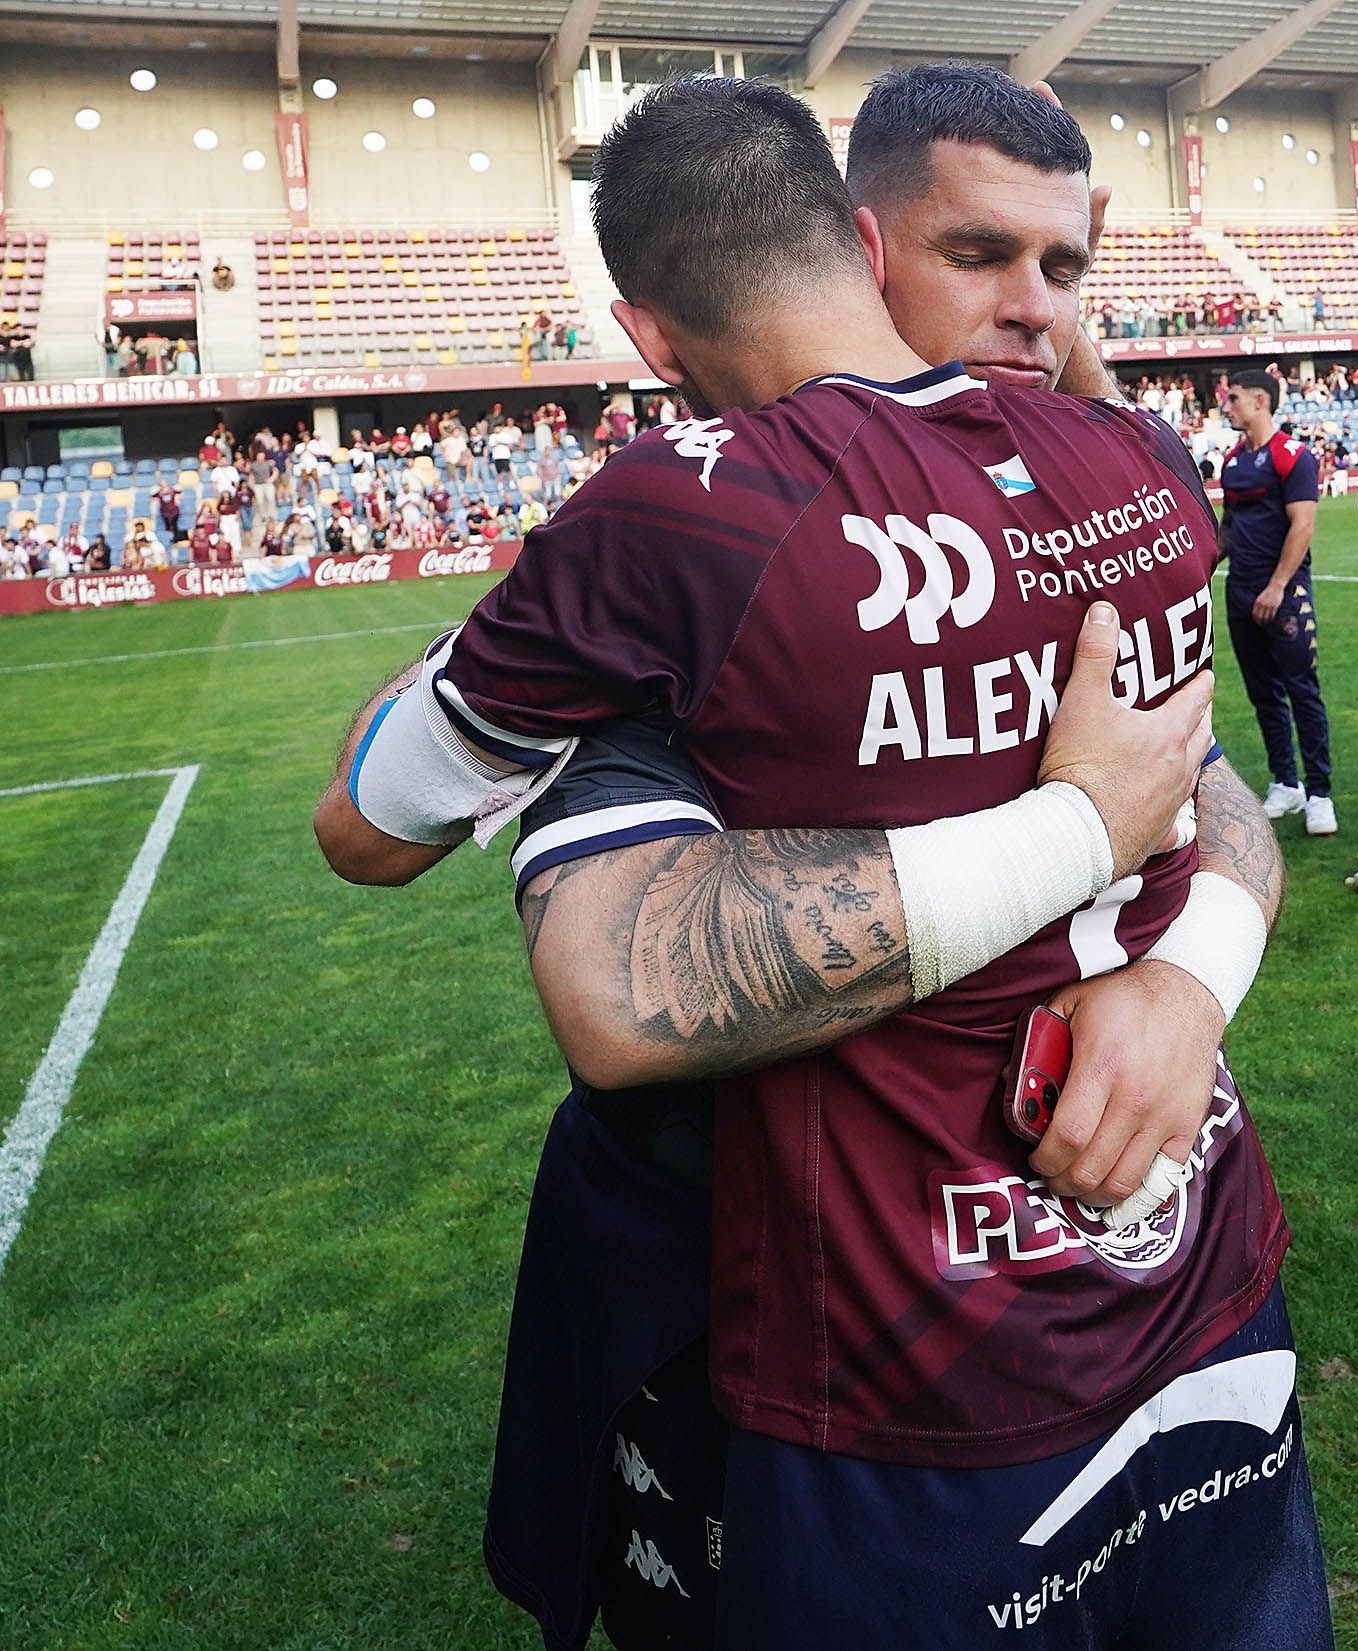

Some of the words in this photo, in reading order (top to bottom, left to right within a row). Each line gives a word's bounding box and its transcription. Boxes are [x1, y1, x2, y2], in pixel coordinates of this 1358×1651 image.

[3, 383, 99, 407] TALLERES
[267, 375, 308, 394] IDC
[1002, 484, 1178, 566] Deputación
[1015, 523, 1193, 602] Pontevedra
[858, 641, 1059, 766] ALEX
